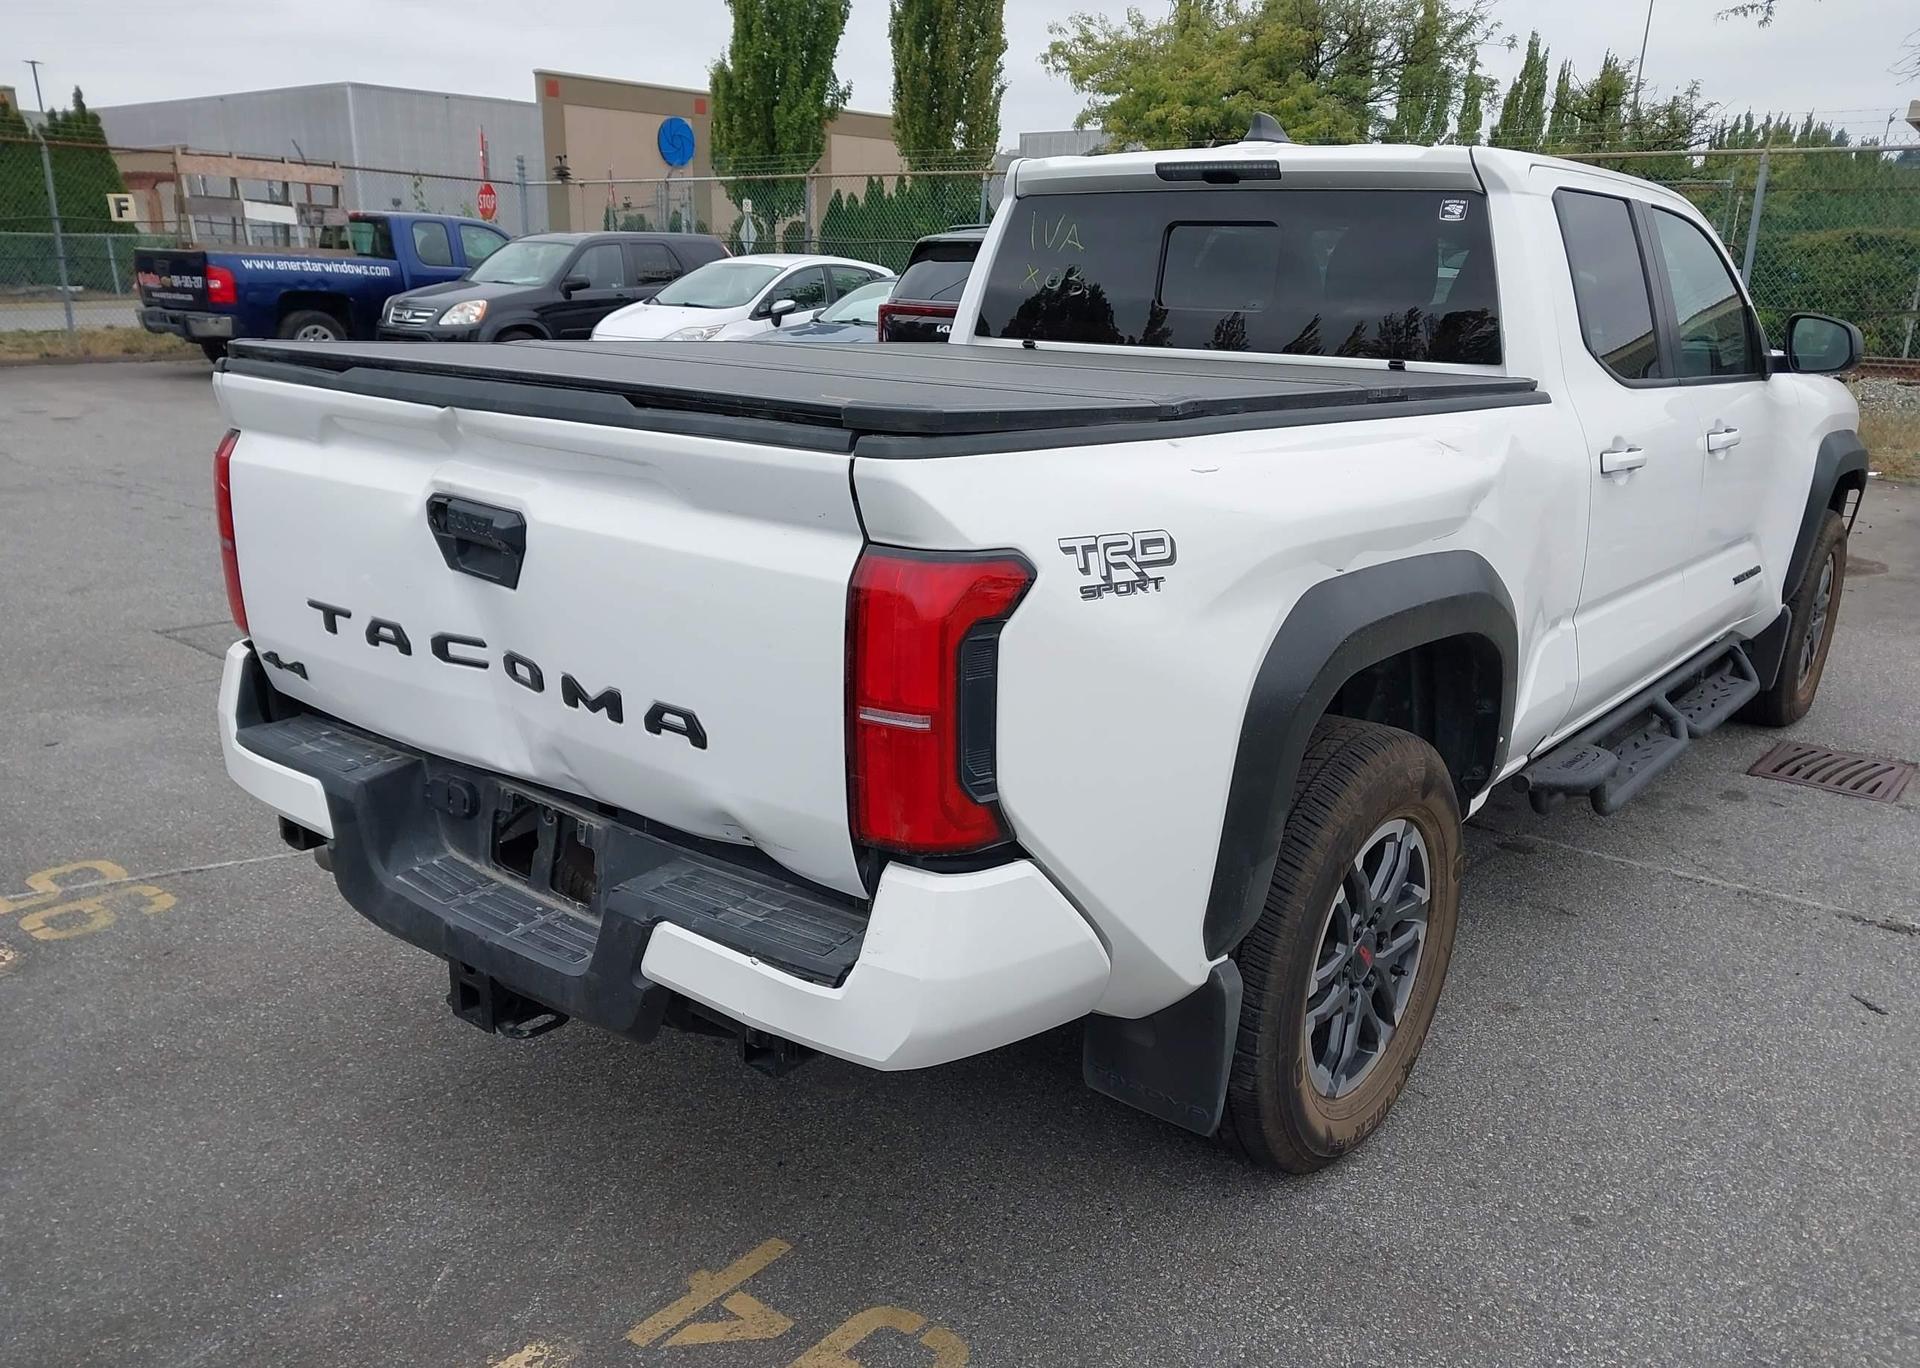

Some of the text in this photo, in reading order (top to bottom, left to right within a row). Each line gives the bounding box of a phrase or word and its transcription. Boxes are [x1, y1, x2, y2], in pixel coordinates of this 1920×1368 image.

[113, 197, 129, 218] F
[241, 258, 391, 277] www.enerstarwindows.com
[1058, 528, 1178, 584] TRD
[1079, 576, 1166, 601] SPORT
[307, 597, 708, 751] TACOMA
